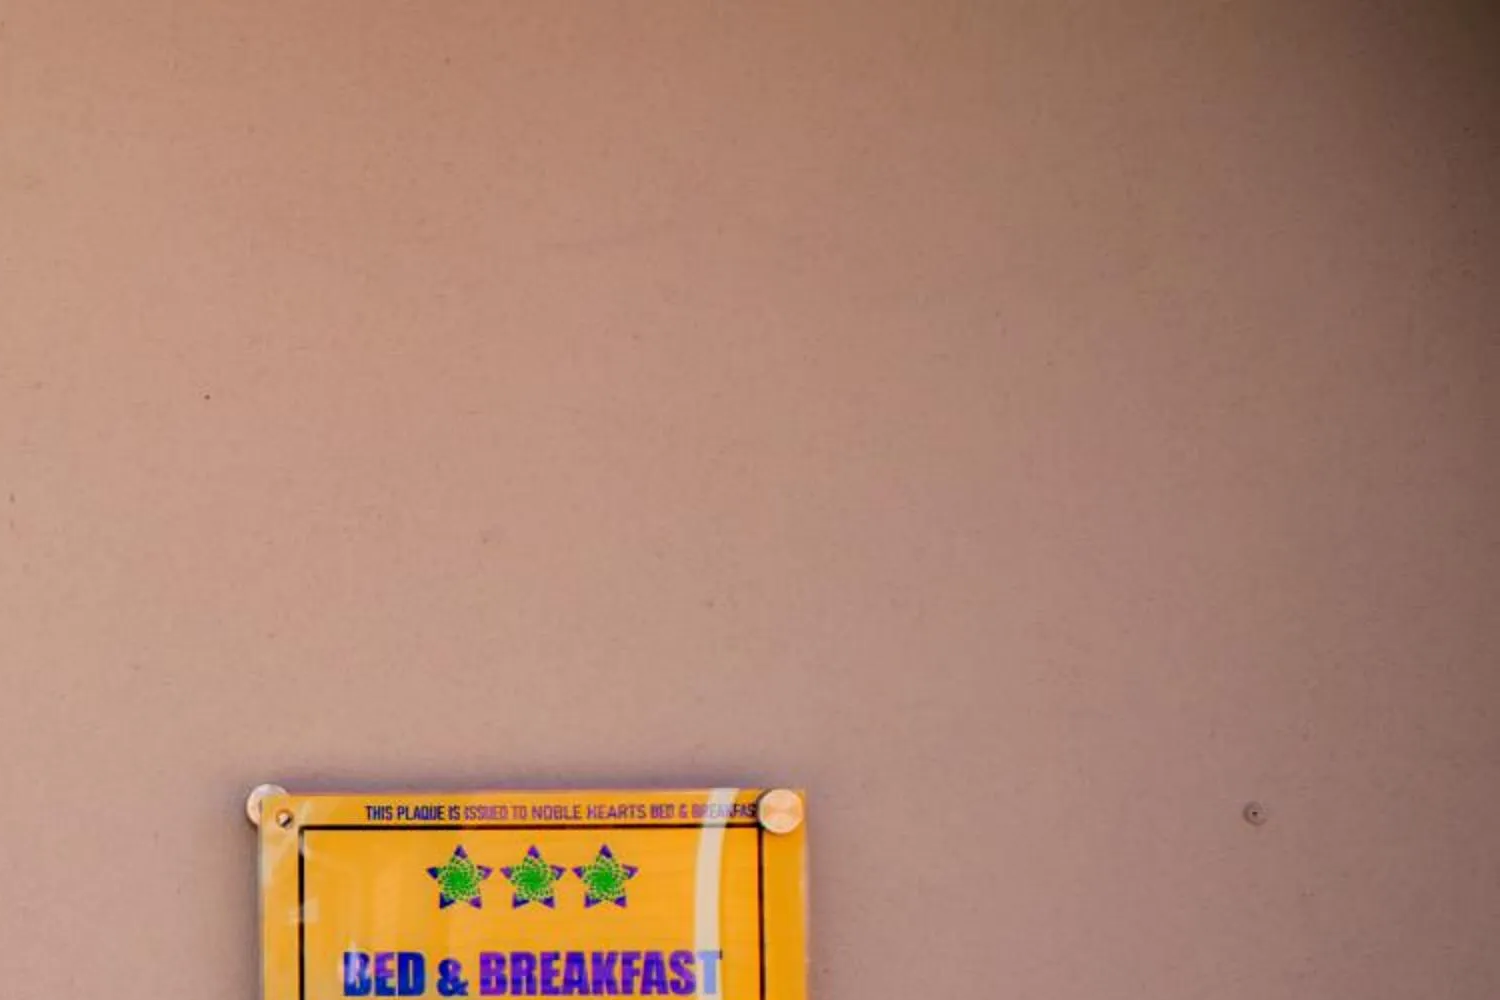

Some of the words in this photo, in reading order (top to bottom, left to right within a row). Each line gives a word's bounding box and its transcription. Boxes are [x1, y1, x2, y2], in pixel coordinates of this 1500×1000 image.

[365, 805, 393, 821] THIS
[397, 805, 445, 821] PLAQUE
[448, 805, 461, 820] IS
[464, 805, 509, 820] ISSUED
[512, 805, 527, 820] TO
[531, 804, 581, 820] NOBLE
[586, 803, 646, 819] HEARTS
[649, 803, 675, 819] BED
[691, 803, 758, 818] BREAKFAS
[343, 951, 426, 997] BED
[436, 957, 469, 997] &
[479, 950, 722, 997] BREAKFAST
